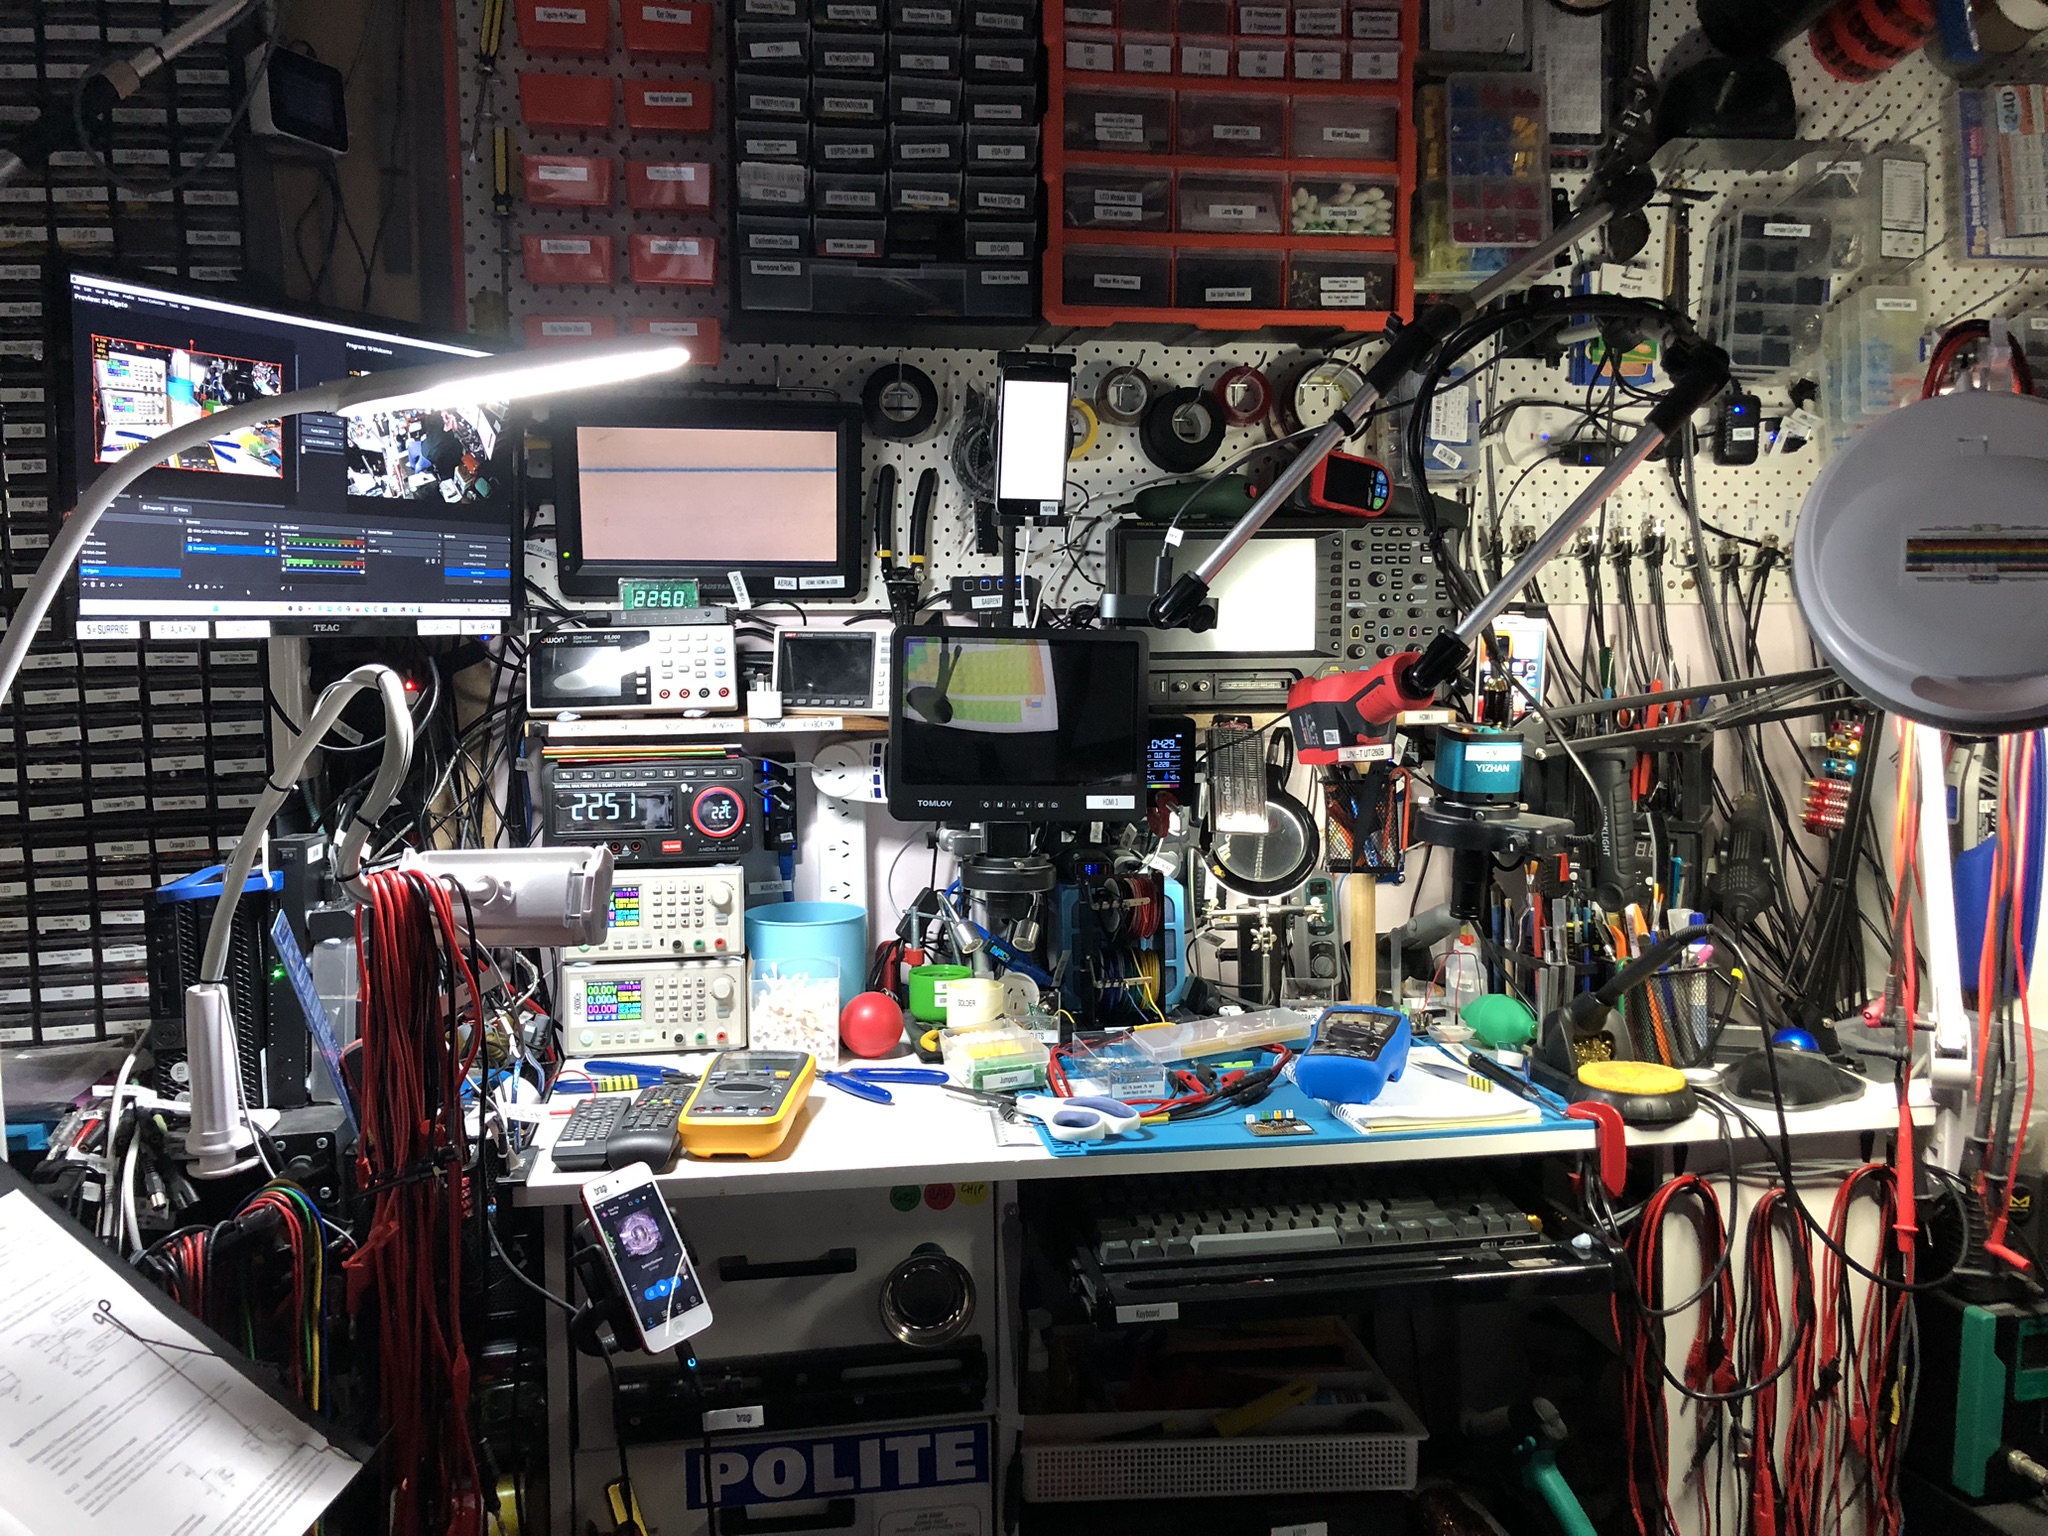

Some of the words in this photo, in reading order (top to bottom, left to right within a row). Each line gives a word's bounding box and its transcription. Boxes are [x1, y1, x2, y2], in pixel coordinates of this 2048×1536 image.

[2002, 91, 2017, 125] 240
[74, 293, 101, 304] Preview:
[346, 342, 367, 351] Program:
[777, 579, 794, 588] AERIAL
[634, 591, 685, 607] 2250
[982, 597, 1002, 606] SABRENT
[87, 625, 93, 635] 5
[98, 624, 130, 635] SURPRISE
[313, 624, 340, 632] TEAC
[1346, 750, 1363, 759] UNI-T
[1476, 764, 1510, 773] YIZHAN
[571, 792, 636, 821] 2251
[917, 799, 953, 808] TOMLOV
[124, 843, 135, 851] LED
[169, 841, 183, 849] Orange
[184, 840, 196, 848] LED
[55, 849, 66, 857] LED
[61, 880, 73, 888] LED
[123, 878, 135, 886] LED
[587, 986, 617, 995] 00.00V
[587, 995, 618, 1004] 0.000A
[957, 998, 976, 1007] SOLDER
[587, 1005, 618, 1014] 00.00W
[1000, 1076, 1018, 1084] Jumpers
[961, 1183, 984, 1196] CHIP
[1135, 1309, 1160, 1319] Keyboard
[737, 1412, 753, 1424] bragi
